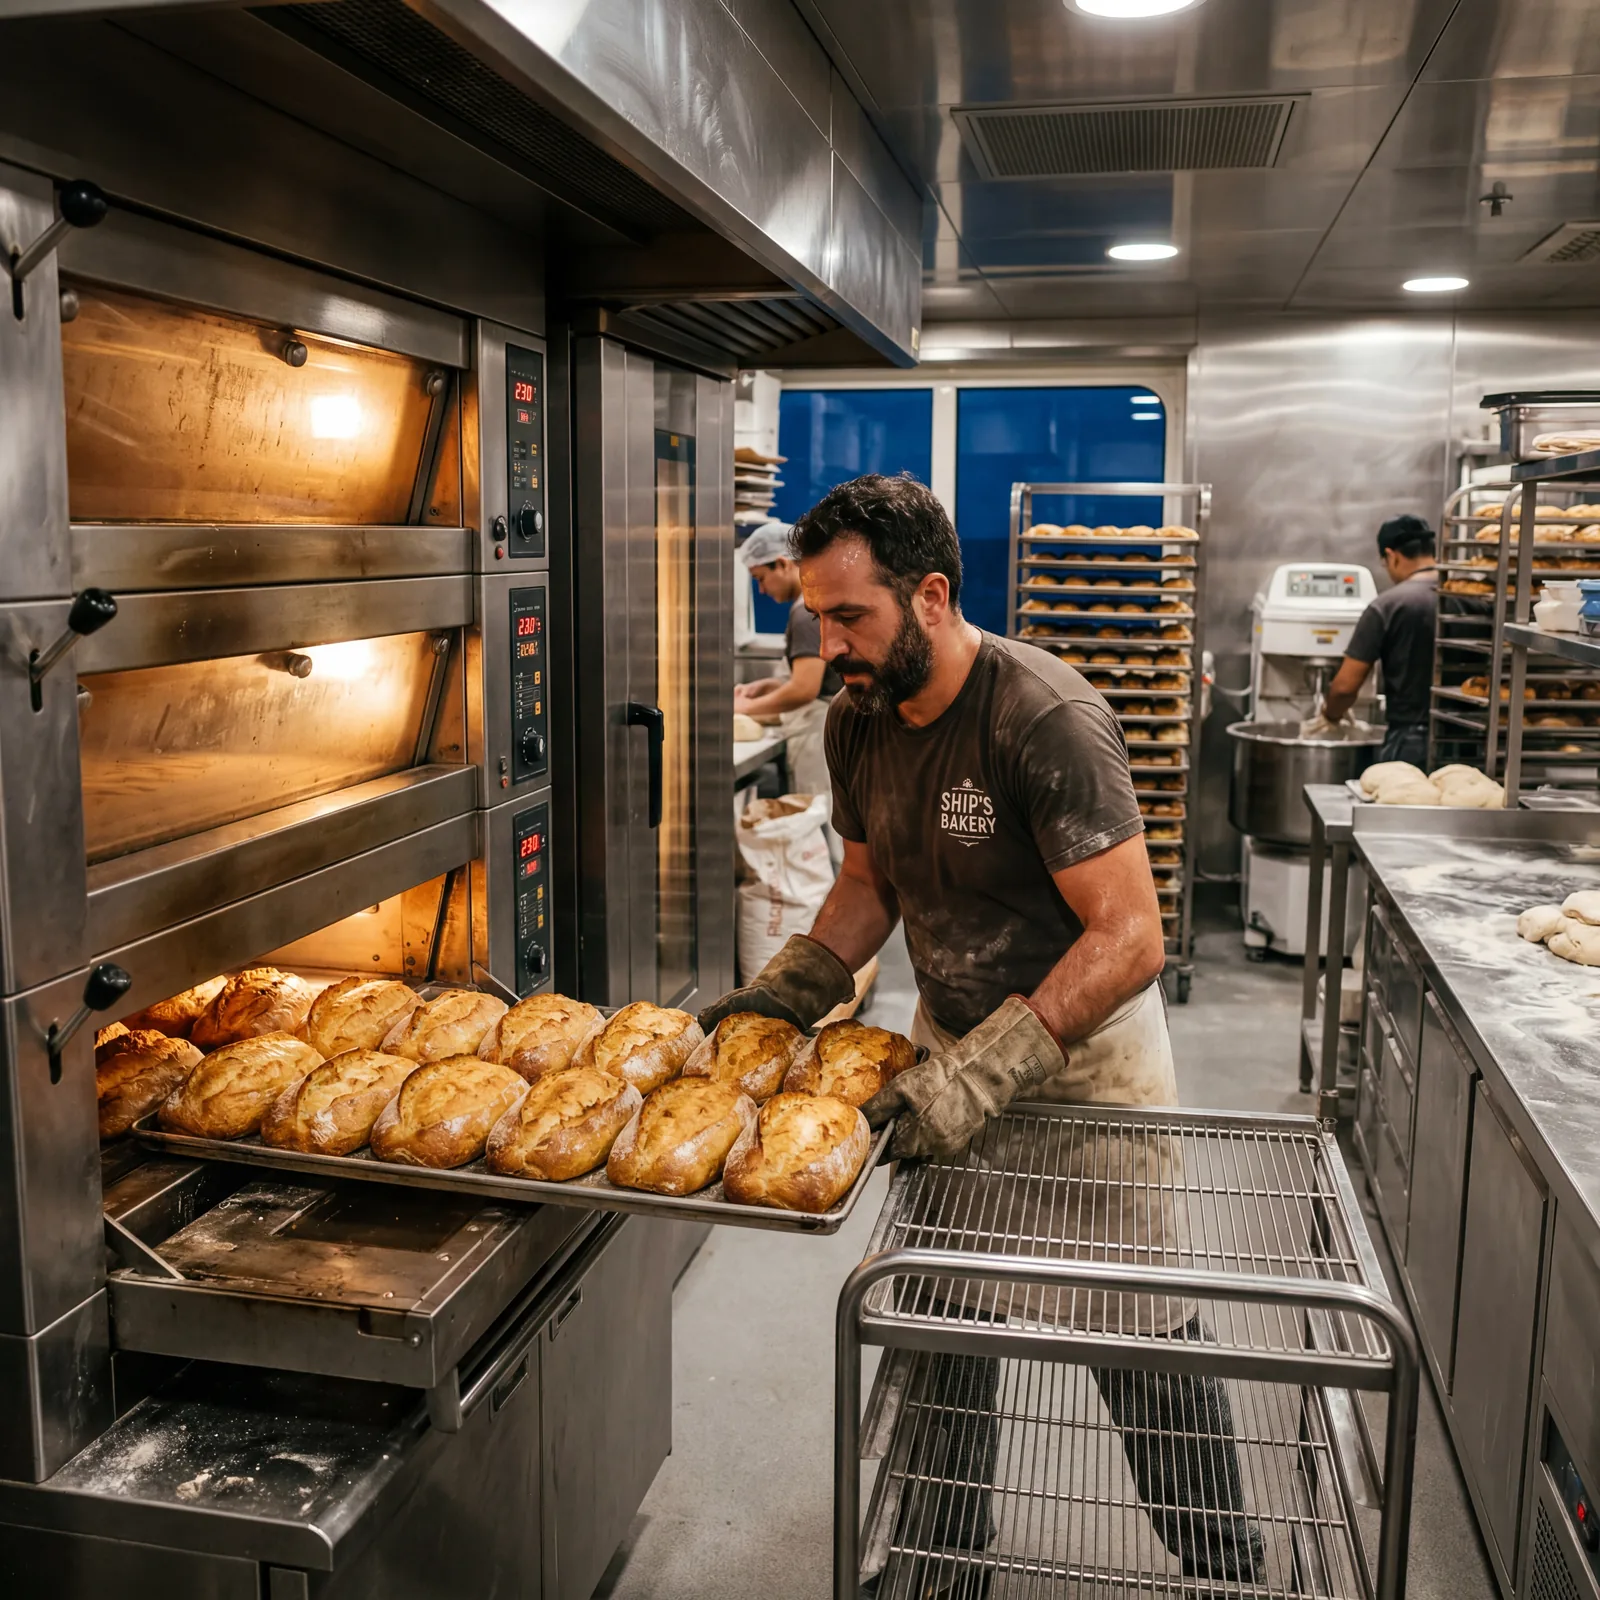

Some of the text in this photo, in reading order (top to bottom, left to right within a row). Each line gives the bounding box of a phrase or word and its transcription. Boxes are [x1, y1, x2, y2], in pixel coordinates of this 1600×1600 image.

[515, 382, 533, 402] 230
[518, 617, 536, 636] 230
[941, 791, 994, 816] SHIP'S
[941, 813, 996, 834] BAKERY
[521, 834, 539, 858] 230
